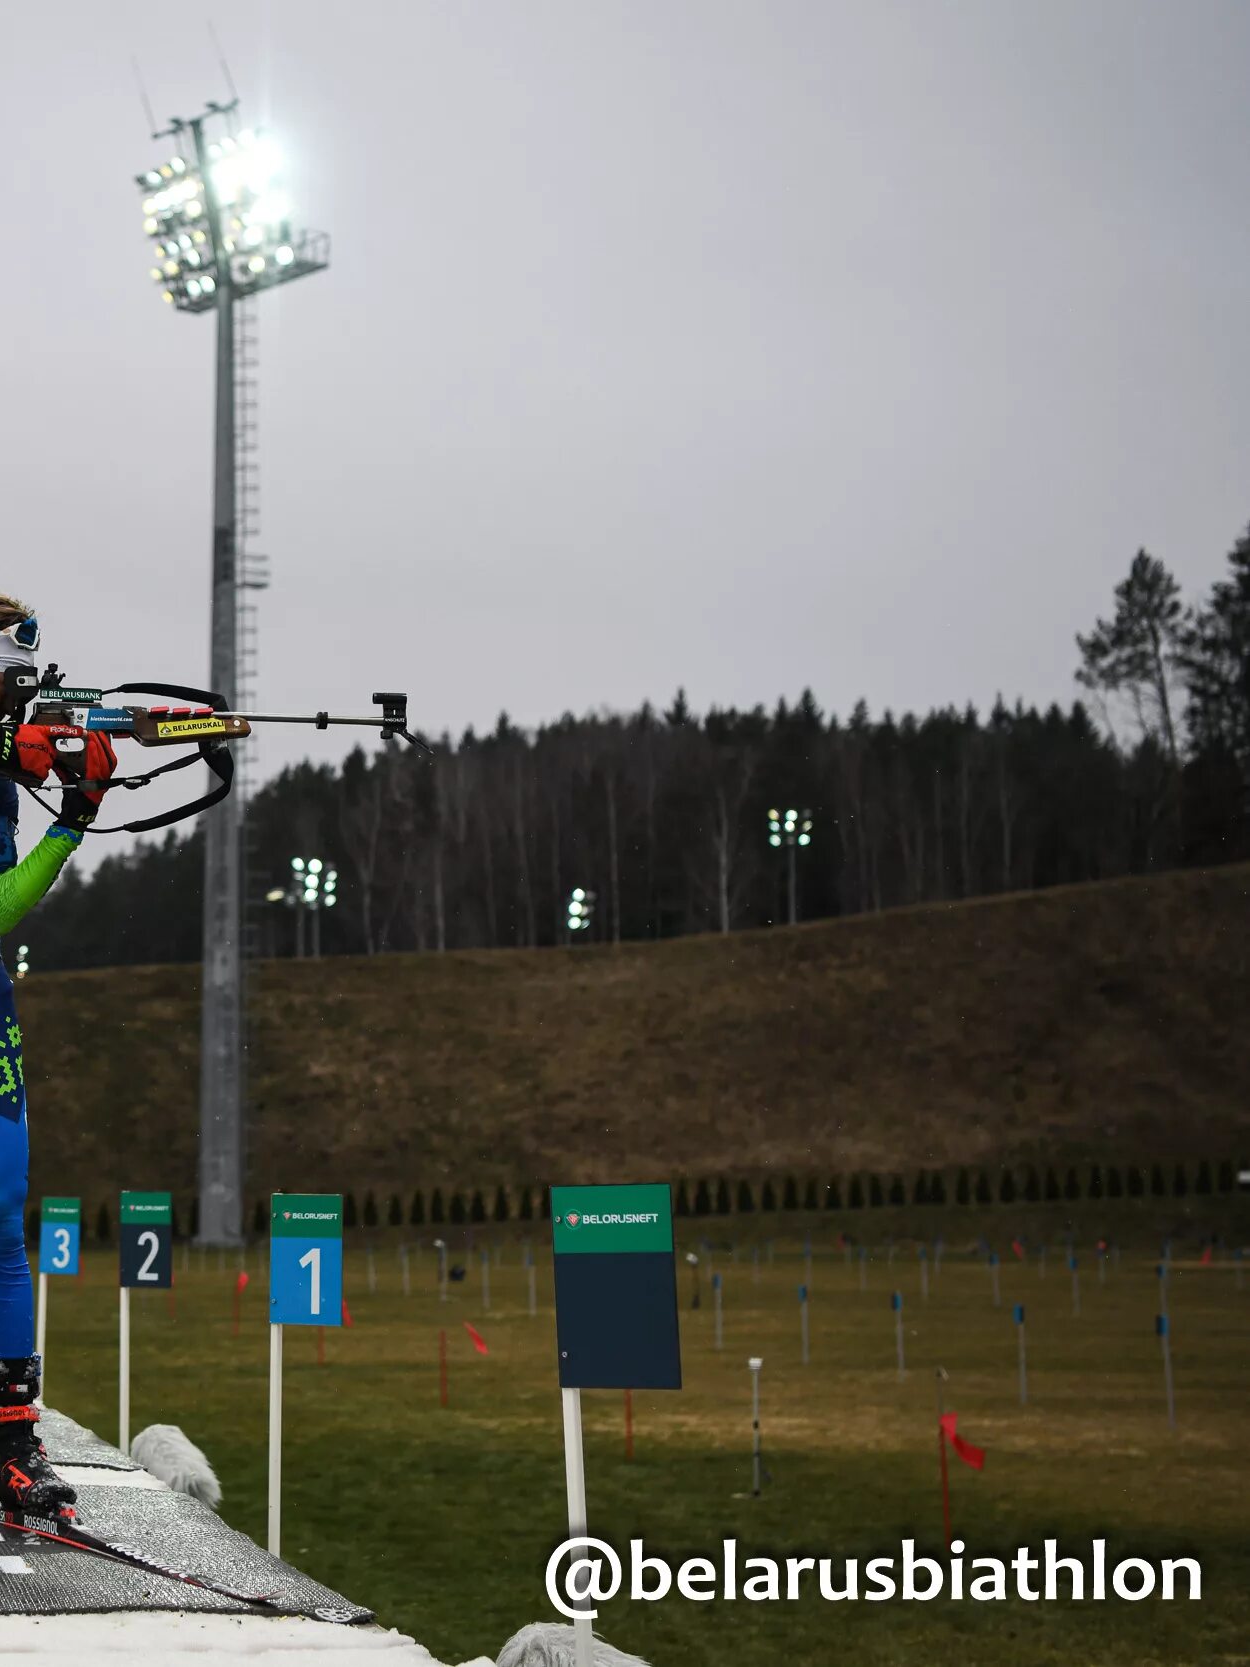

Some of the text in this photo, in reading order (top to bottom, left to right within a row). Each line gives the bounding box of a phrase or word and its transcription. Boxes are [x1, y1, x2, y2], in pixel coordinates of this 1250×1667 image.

[49, 690, 100, 700] BELARUSBANK
[173, 721, 224, 732] BELARUSKALI
[2, 730, 13, 761] LEKI
[292, 1212, 338, 1220] BELORUSNEFT
[582, 1213, 658, 1224] BELORUSNEFT
[52, 1228, 70, 1268] 3
[137, 1231, 159, 1280] 2
[299, 1248, 320, 1315] 1
[24, 1515, 59, 1536] ROSSIGNOL
